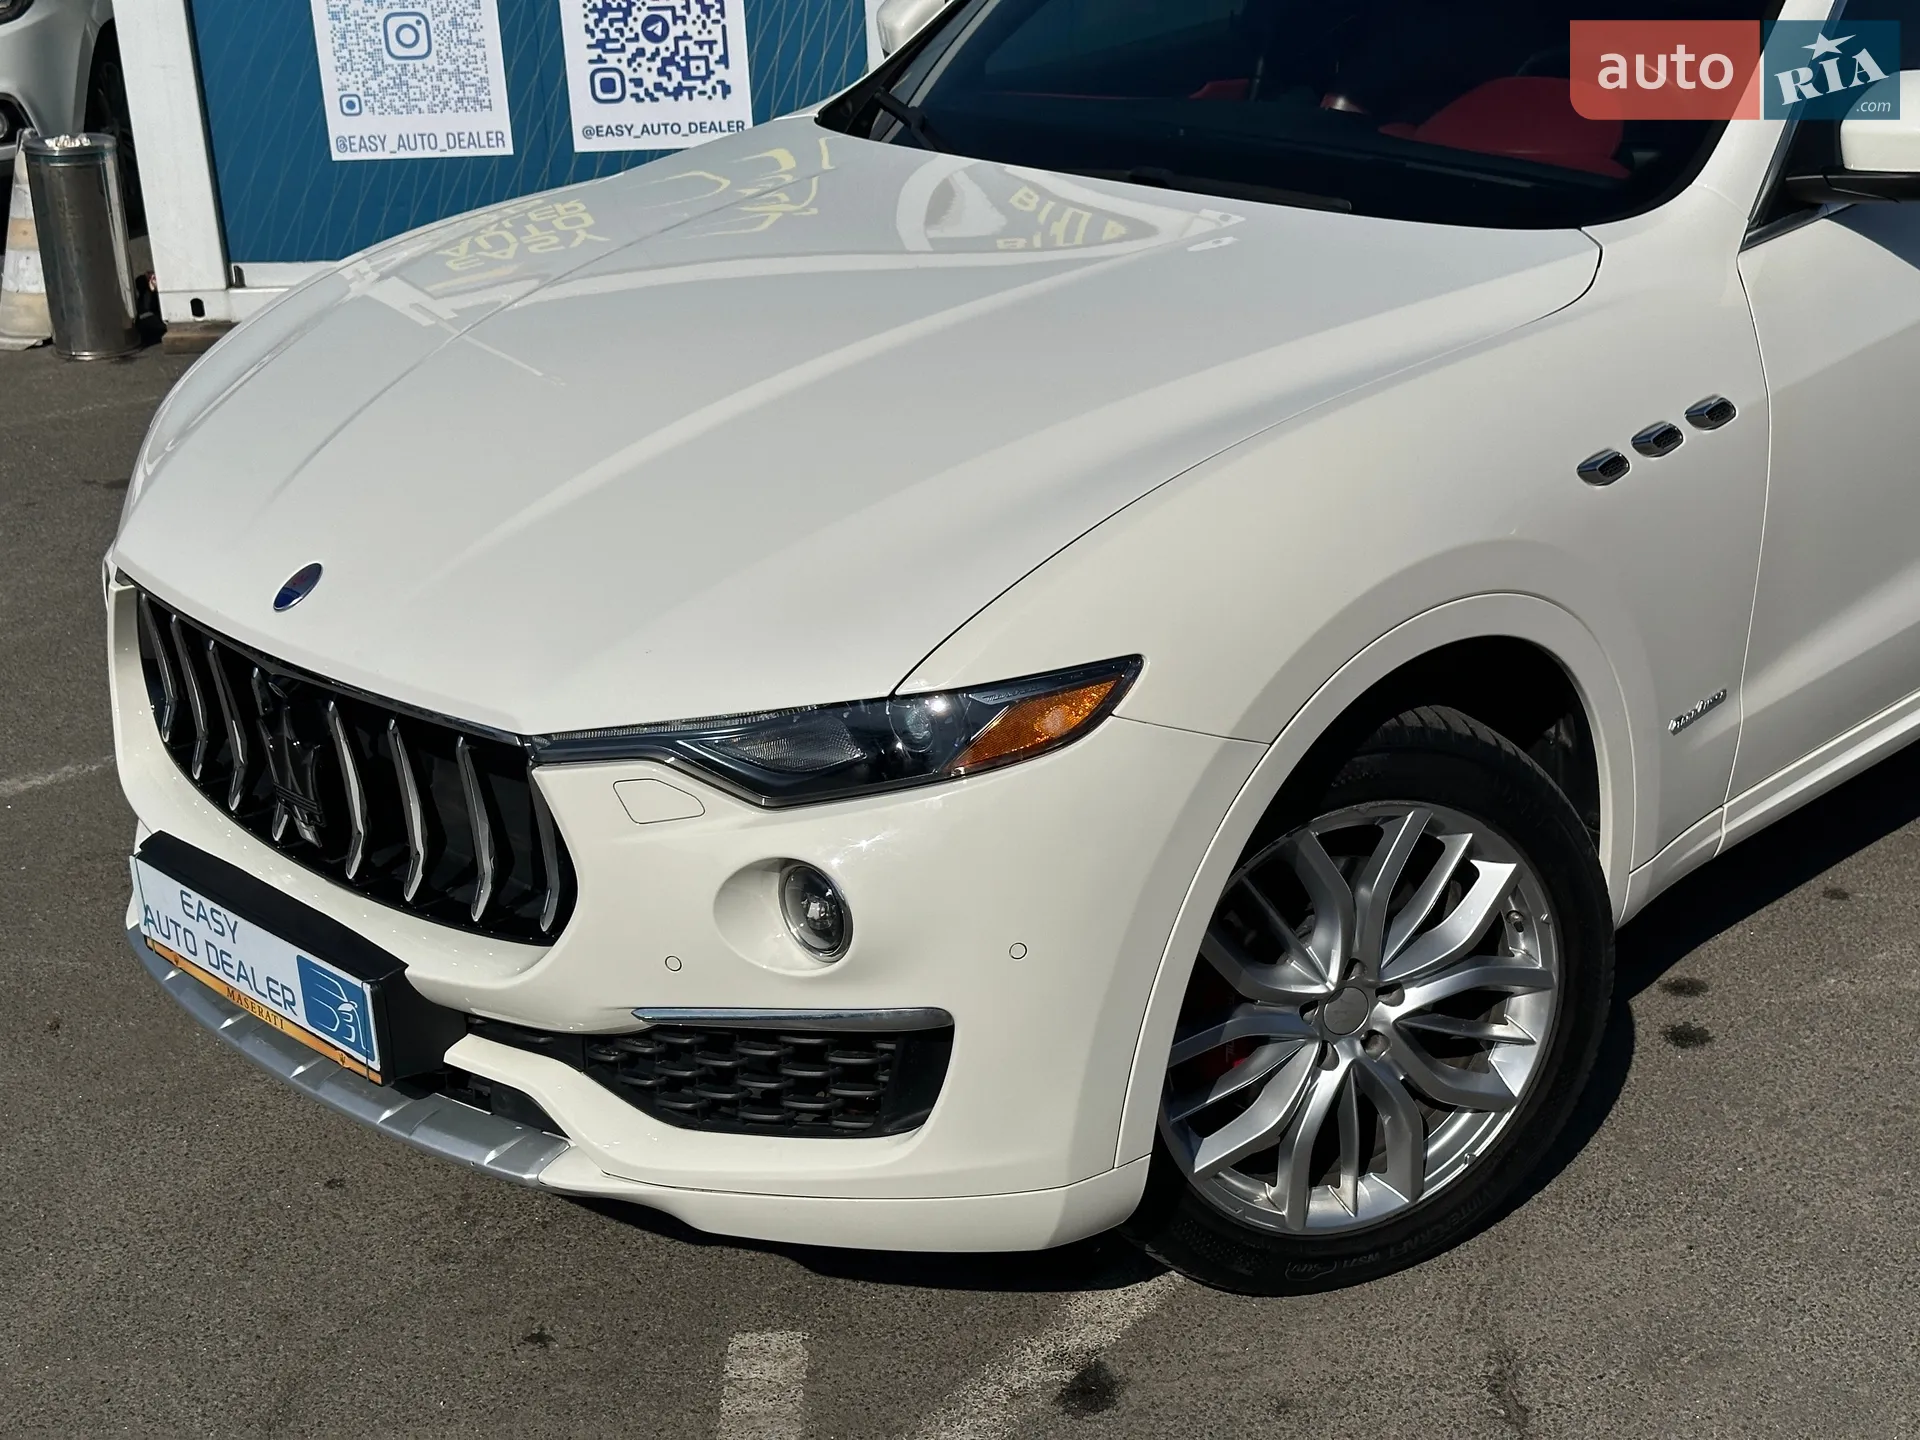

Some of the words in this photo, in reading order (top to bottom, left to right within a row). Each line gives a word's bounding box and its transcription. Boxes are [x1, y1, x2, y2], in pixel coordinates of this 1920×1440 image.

[335, 130, 506, 154] @EASY_AUTO_DEALER
[582, 119, 745, 139] @EASY_AUTO_DEALER
[180, 889, 239, 944] EASY
[143, 904, 198, 957] AUTO
[205, 939, 298, 1016] DEALER
[226, 986, 285, 1030] MASERATI
